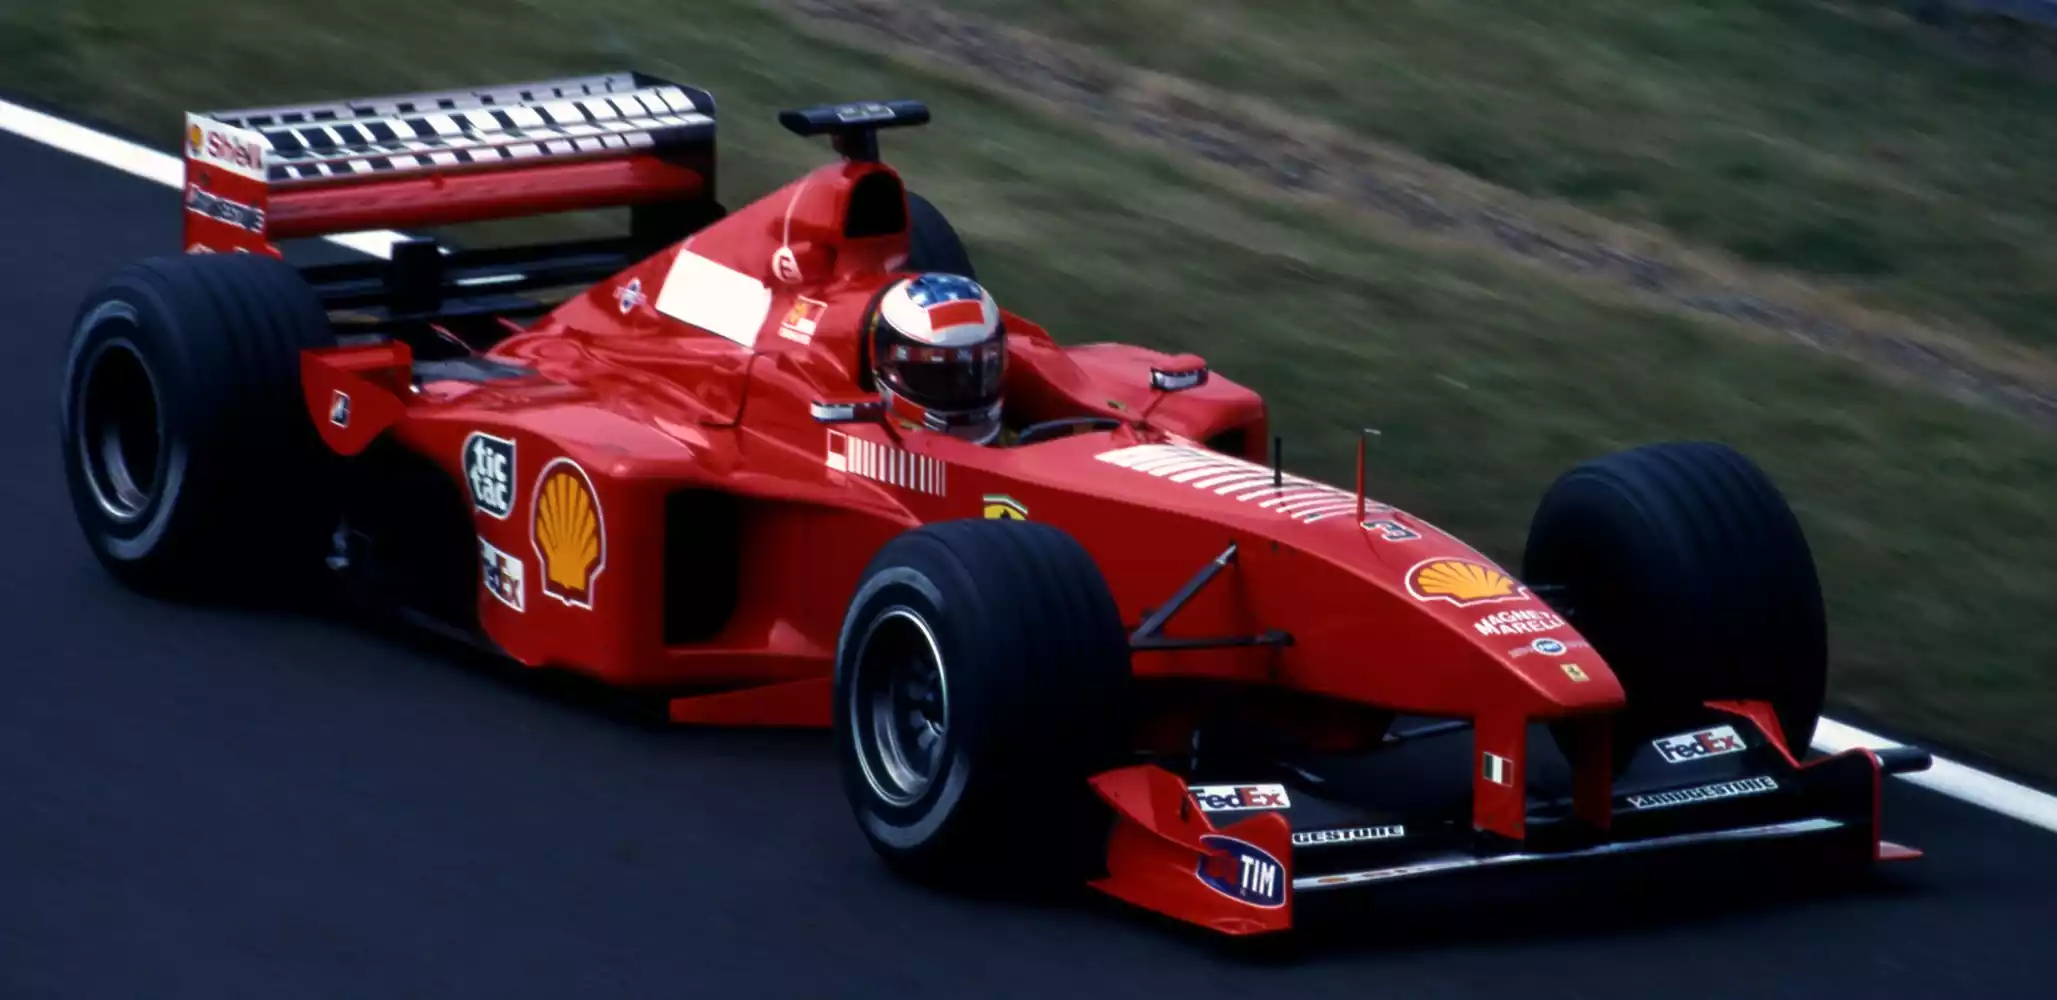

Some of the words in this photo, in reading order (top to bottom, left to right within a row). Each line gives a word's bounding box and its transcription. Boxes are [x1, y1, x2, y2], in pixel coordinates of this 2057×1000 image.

[207, 130, 262, 170] Shell
[473, 438, 507, 481] tic
[469, 463, 507, 511] tac
[1658, 732, 1742, 760] FedEx
[1241, 855, 1276, 898] TIM
